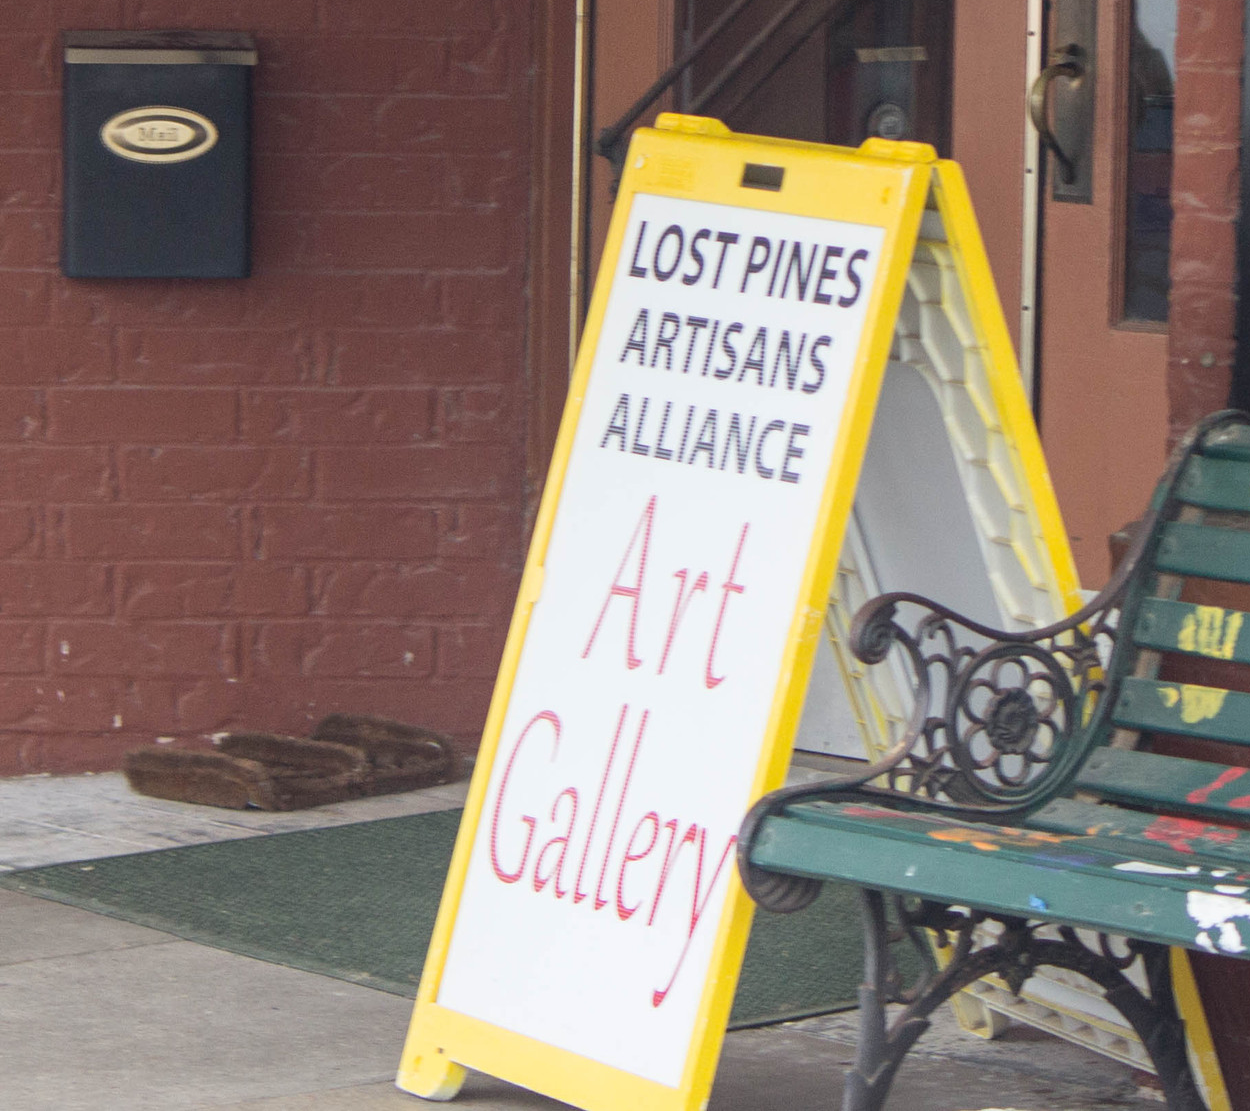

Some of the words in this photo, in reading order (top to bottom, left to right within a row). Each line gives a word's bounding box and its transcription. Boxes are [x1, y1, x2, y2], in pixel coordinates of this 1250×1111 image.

[628, 220, 740, 290] LOST
[739, 235, 871, 309] PINES
[618, 307, 834, 395] ARTISANS
[599, 392, 812, 485] ALLIANCE
[580, 494, 751, 690] Art
[489, 703, 739, 1008] Gallery
